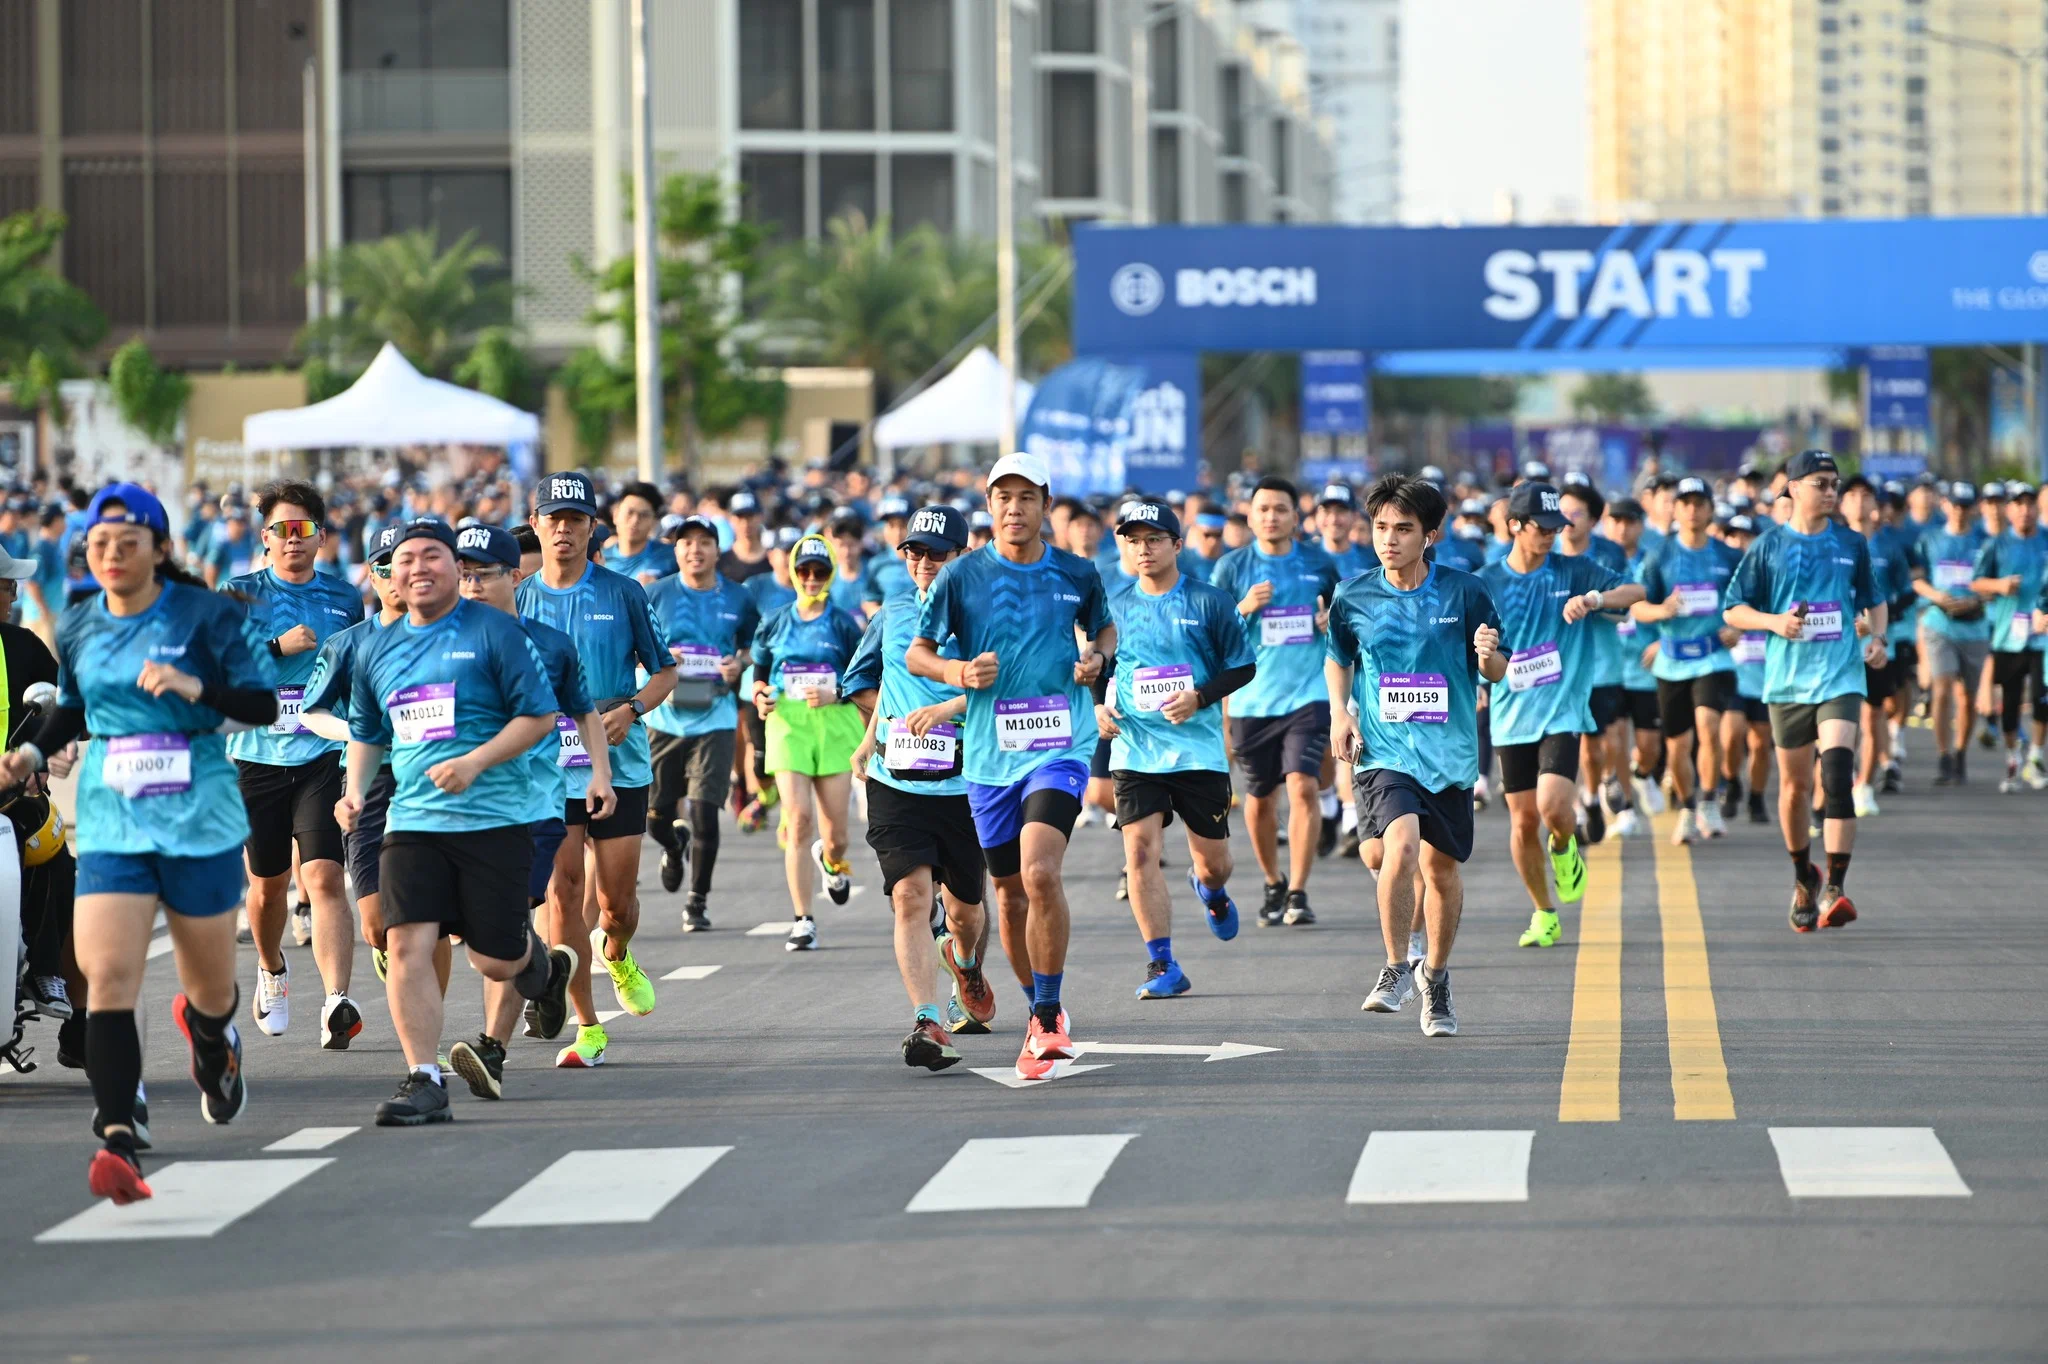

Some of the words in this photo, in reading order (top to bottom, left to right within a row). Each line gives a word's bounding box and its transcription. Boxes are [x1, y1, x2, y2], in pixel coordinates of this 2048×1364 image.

[1176, 267, 1317, 306] BOSCH
[1484, 250, 1767, 320] START
[551, 479, 584, 488] Bosch
[551, 486, 585, 500] RUN
[1542, 499, 1559, 511] RU
[1129, 509, 1158, 521] RUN
[911, 519, 945, 534] RUN
[457, 533, 490, 549] RUN
[593, 613, 614, 621] BOSCH
[1802, 616, 1836, 626] 10170
[452, 651, 475, 659] BOSCH
[1140, 681, 1185, 694] M10070
[1388, 692, 1439, 703] M10159
[400, 705, 444, 721] M10112
[1006, 716, 1060, 730] M10016
[560, 735, 580, 747] 100
[894, 737, 946, 752] M10083
